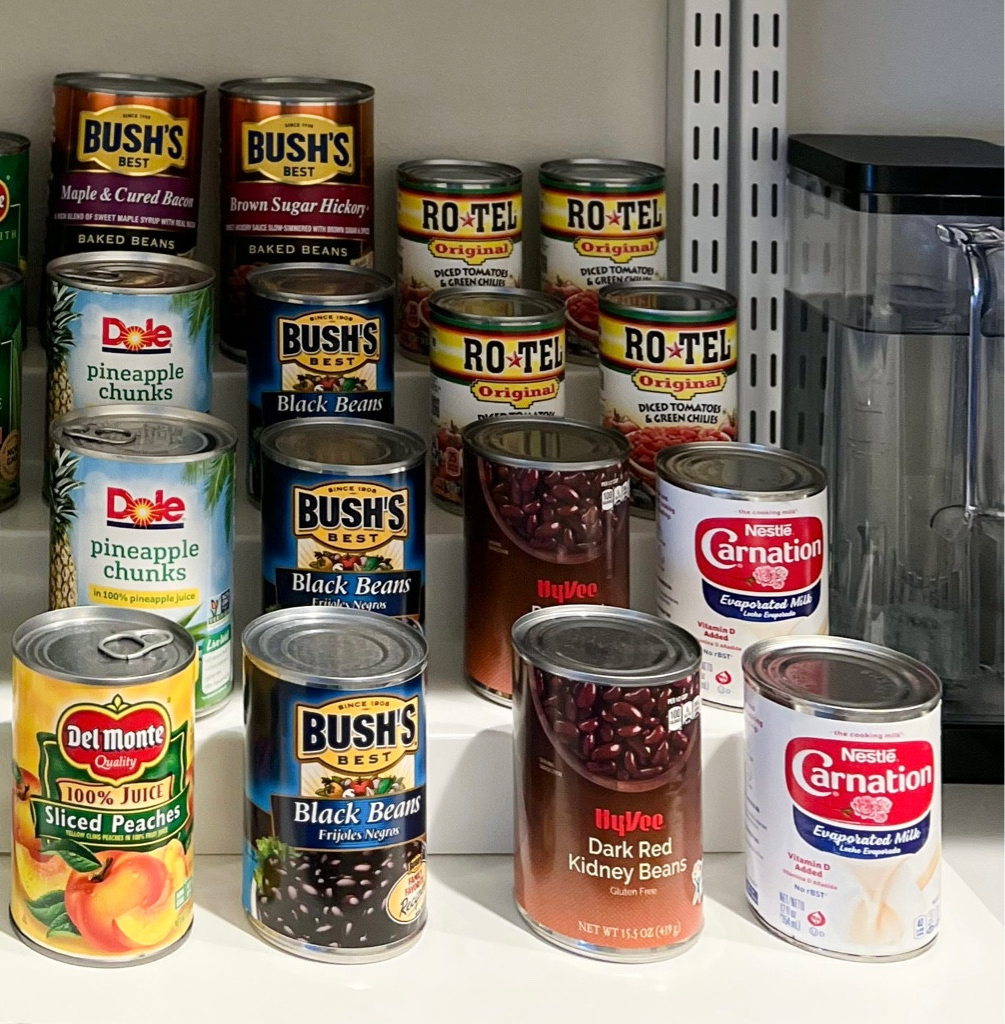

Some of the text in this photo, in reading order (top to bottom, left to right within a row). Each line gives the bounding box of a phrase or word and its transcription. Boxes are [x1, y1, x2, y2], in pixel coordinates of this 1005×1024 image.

[83, 119, 183, 159] BUSH'S
[248, 130, 349, 166] BUSH'S
[119, 157, 149, 168] BEST
[283, 167, 315, 176] BEST
[61, 185, 194, 208] Maple & Cured Bacon
[230, 197, 365, 218] Brown Sugar Hickory
[79, 235, 174, 249] BAKED BEANS
[249, 245, 347, 256] BAKED BEANS
[434, 268, 508, 277] DICED TOMATOES
[580, 266, 654, 276] DICED TOMATOES
[103, 317, 172, 352] Dole
[283, 322, 378, 354] BUSH'S
[310, 358, 355, 366] BEST
[87, 362, 184, 385] pineapple
[99, 383, 173, 401] chunks
[479, 384, 554, 401] Original
[278, 395, 383, 412] Black Beans
[638, 403, 721, 413] DICED TOMATOES
[646, 415, 652, 423] &
[687, 415, 718, 424] CHILIES
[107, 487, 185, 527] Dole
[299, 492, 404, 530] BUSH'S
[328, 534, 378, 542] BEST
[745, 523, 792, 536] Nestlé
[91, 538, 199, 564] pineapple
[701, 527, 821, 569] Carnation
[104, 561, 186, 582] chunks
[292, 573, 411, 595] Black Beans
[94, 589, 195, 604] in 100% pineapple juice
[697, 622, 727, 633] Vitamin
[704, 631, 728, 641] Added
[338, 701, 366, 710] SINCE
[303, 703, 416, 752] BUSH'S
[850, 731, 883, 740] cooking
[67, 725, 164, 750] Del Monte
[95, 755, 137, 769] Quality
[842, 747, 896, 763] Nestlé
[792, 749, 932, 797] Carnation
[67, 783, 163, 805] 100% JUICE
[295, 794, 422, 824] Black Beans
[45, 804, 181, 834] Sliced Peaches
[319, 826, 400, 842] Frijoles Negros
[813, 825, 921, 848] Evaporated Milk
[589, 837, 672, 858] Dark Red
[569, 853, 687, 885] Kidney Beans
[610, 886, 657, 896] Gluten Free
